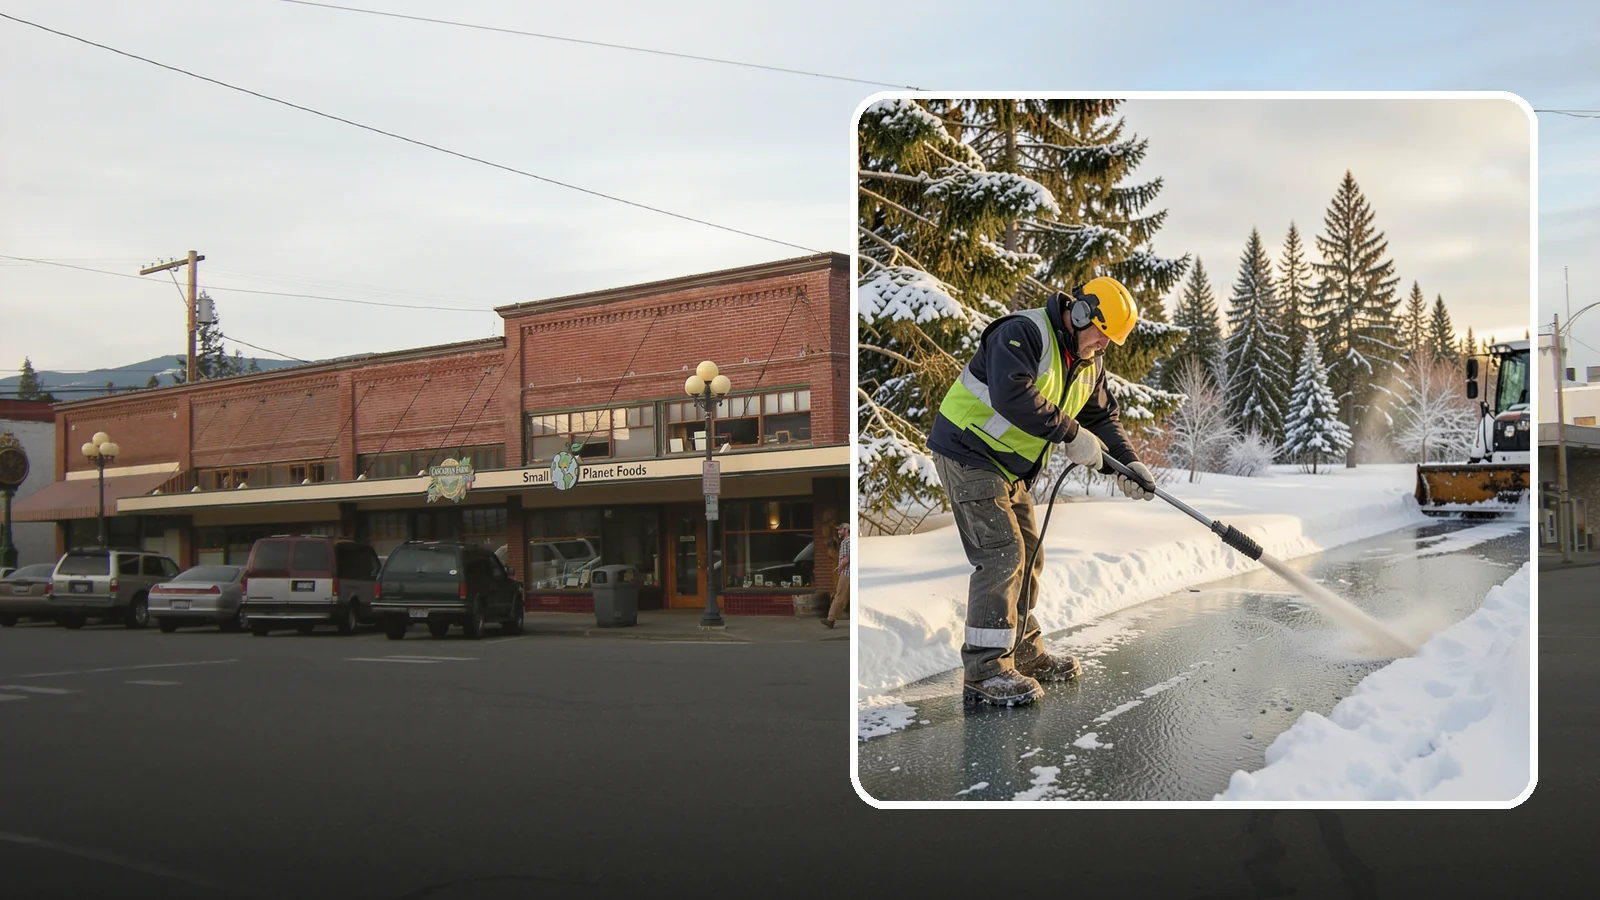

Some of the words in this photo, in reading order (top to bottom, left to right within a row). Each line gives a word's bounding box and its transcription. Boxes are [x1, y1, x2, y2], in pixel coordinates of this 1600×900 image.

[523, 471, 549, 483] Small
[582, 466, 614, 480] Planet
[617, 464, 647, 477] Foods
